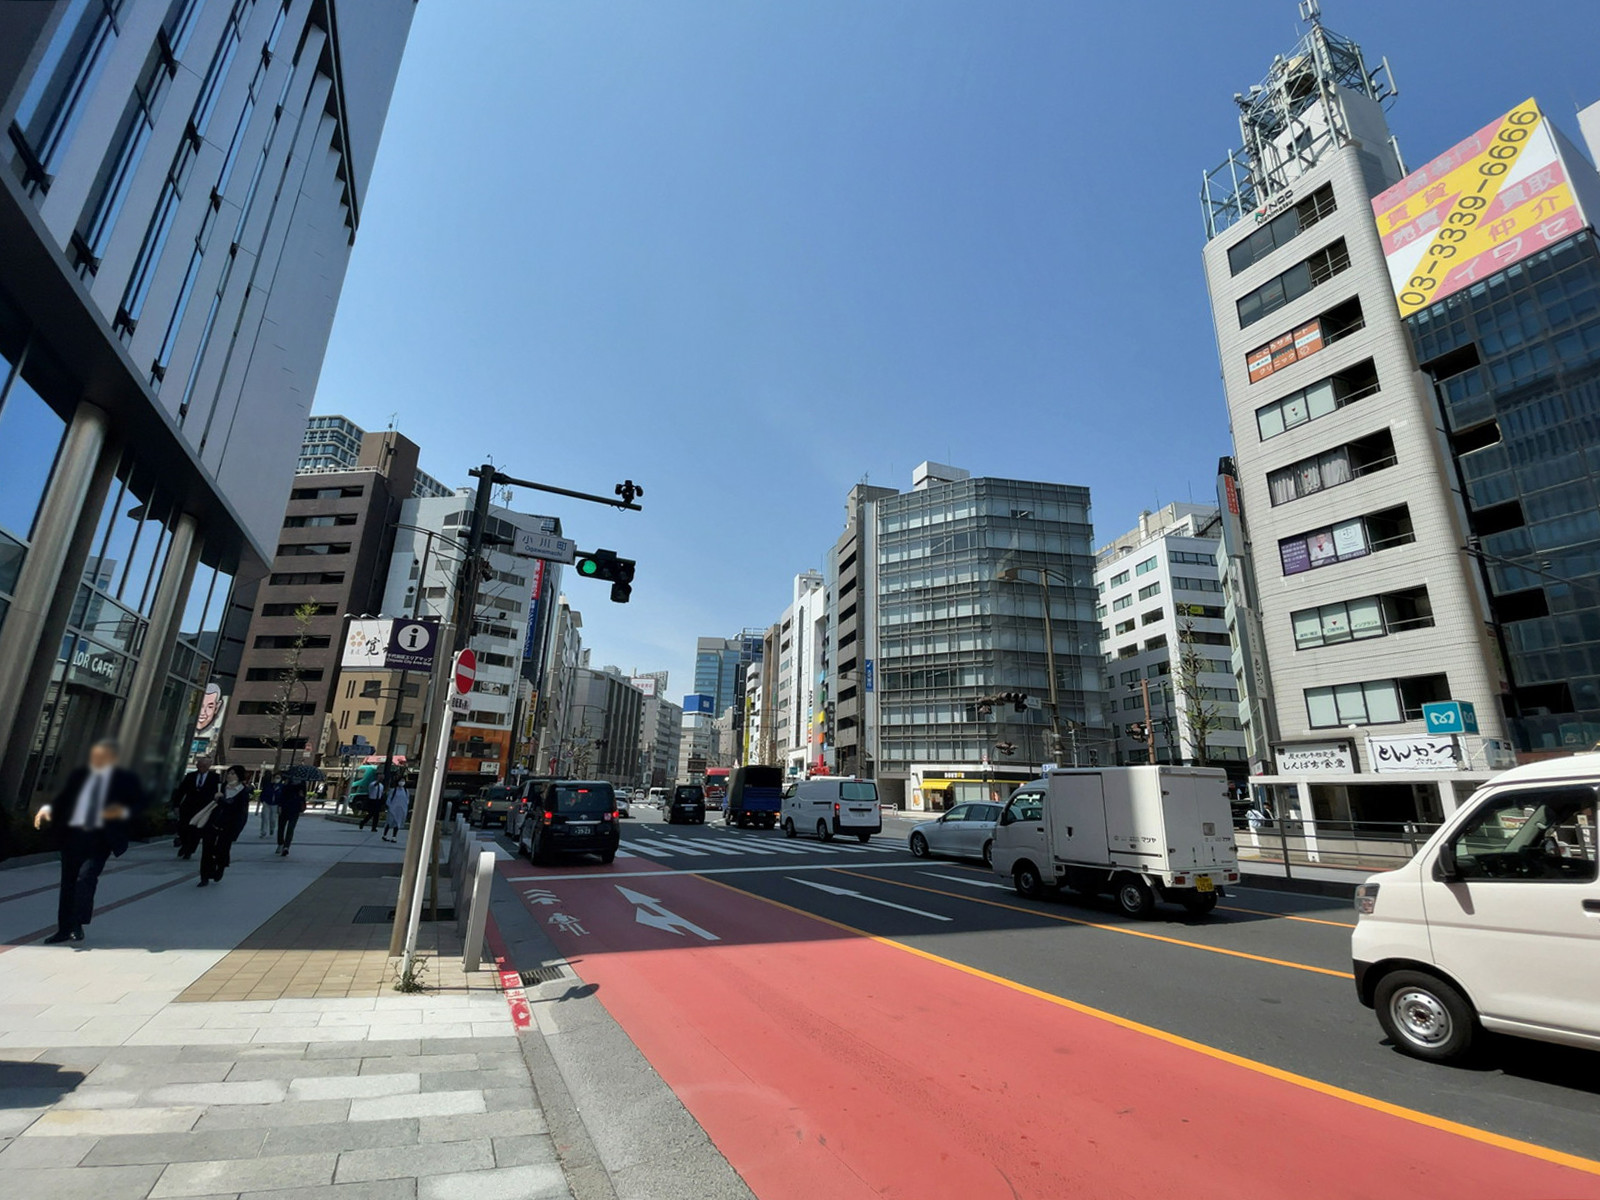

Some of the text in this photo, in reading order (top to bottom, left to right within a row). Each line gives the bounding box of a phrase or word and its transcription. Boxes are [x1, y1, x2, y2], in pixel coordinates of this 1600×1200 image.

[1400, 110, 1538, 306] 03-3339-6666
[1499, 172, 1557, 211] 買取
[1488, 195, 1560, 242] 仲介
[1454, 217, 1569, 281] イワセ
[522, 535, 567, 551] 小川町
[1377, 742, 1459, 764] とんかつ
[1141, 835, 1157, 844] マツヤ
